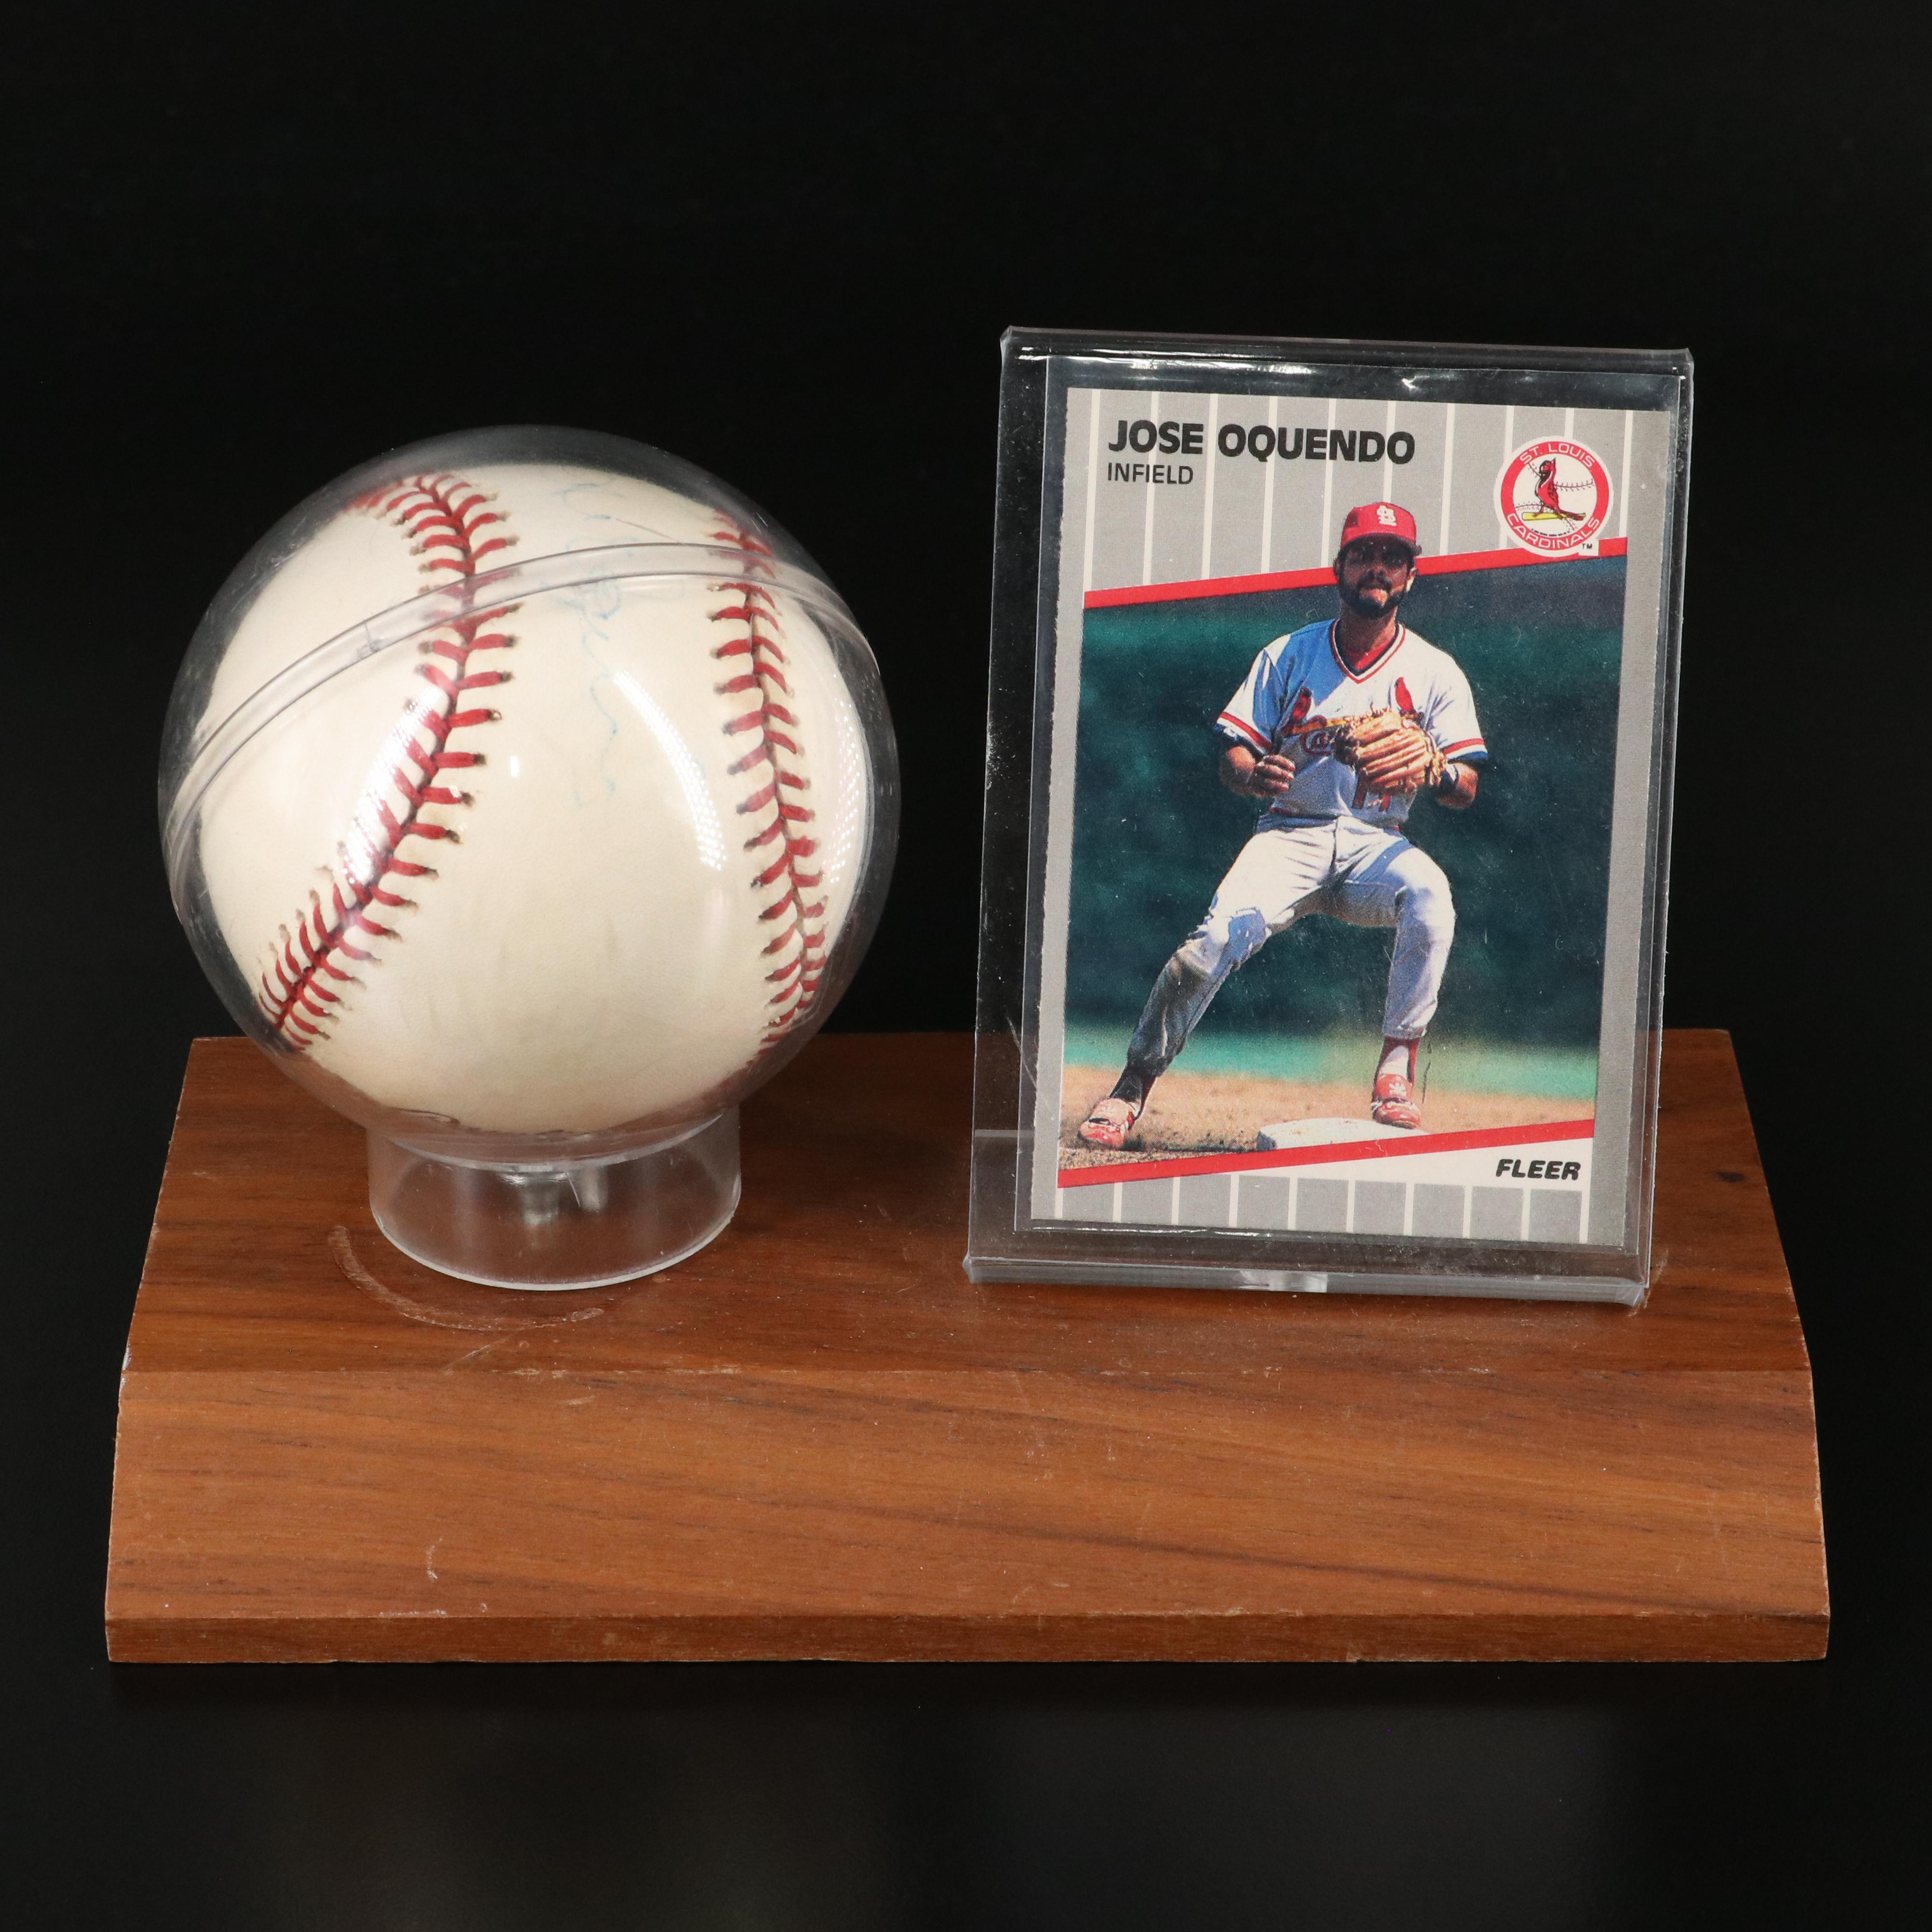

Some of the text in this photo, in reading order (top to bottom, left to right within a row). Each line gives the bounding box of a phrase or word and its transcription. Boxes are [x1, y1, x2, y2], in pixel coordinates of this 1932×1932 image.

[1108, 420, 1415, 465] JOSE OQUENDO
[1548, 442, 1596, 468] LOUIS
[1108, 462, 1193, 484] INFIELD
[1507, 513, 1600, 549] CARDINALS
[1496, 1159, 1581, 1180] FLEER
